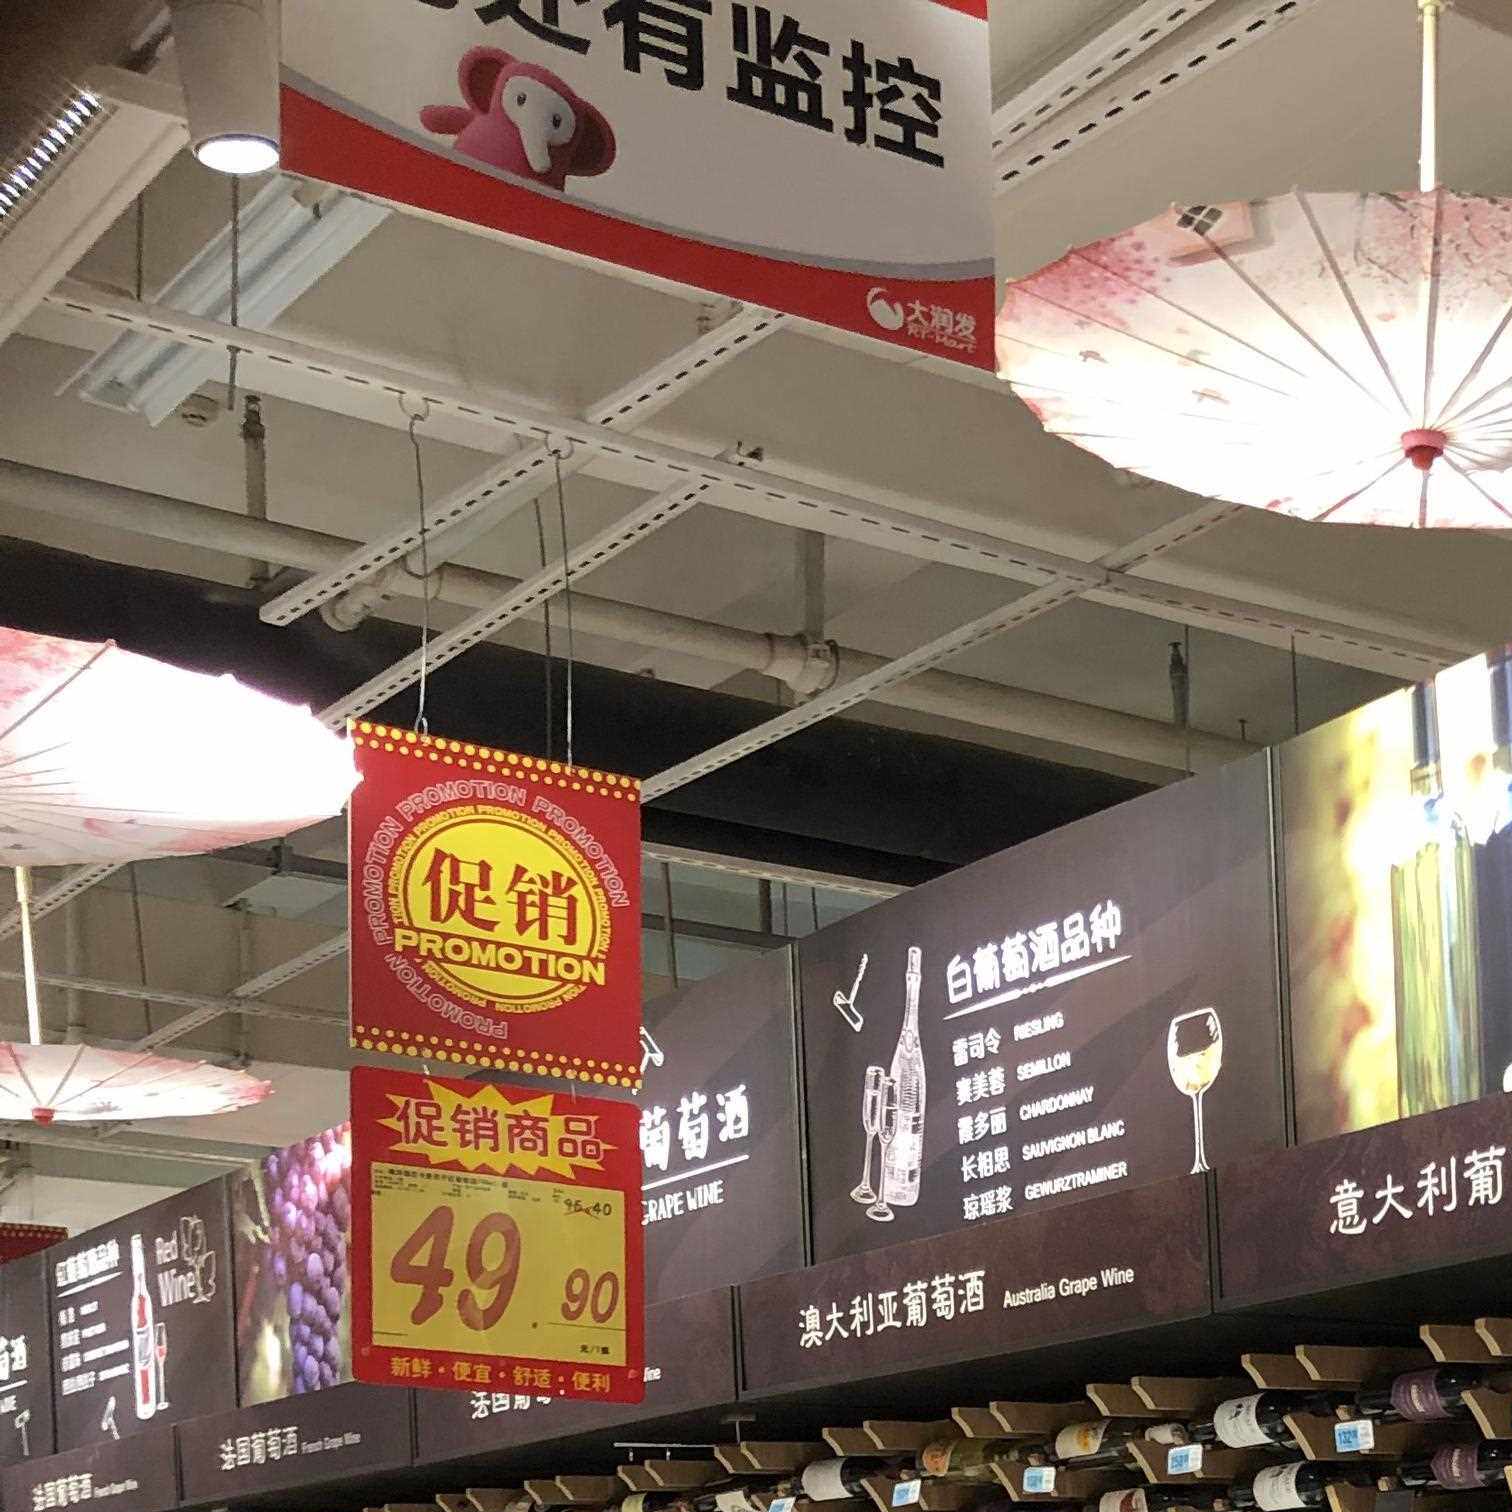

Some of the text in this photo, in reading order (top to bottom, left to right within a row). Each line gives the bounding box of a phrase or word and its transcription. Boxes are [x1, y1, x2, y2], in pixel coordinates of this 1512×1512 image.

[419, 0, 944, 168] 有监控
[362, 779, 630, 946] PROMOTION PROMOTION PROMOTION
[423, 847, 579, 946] 促销
[394, 928, 606, 986] PROMOTION
[945, 900, 1123, 1004] 白葡萄酒品种
[952, 1011, 1064, 1067] 雷司令 RIESLING
[396, 1099, 602, 1160] 促销商品
[1019, 1086, 1095, 1121] CHARDONNAY
[961, 1119, 1126, 1183] 长相思 SAUVIGNON BLANC
[686, 1179, 724, 1211] WINE
[963, 1161, 1128, 1221] 琼瑶浆 GEWURZTRAMINER
[390, 1205, 620, 1331] 49 90
[799, 1266, 1135, 1349] 澳大利亚葡萄酒 Australia Grape Wine
